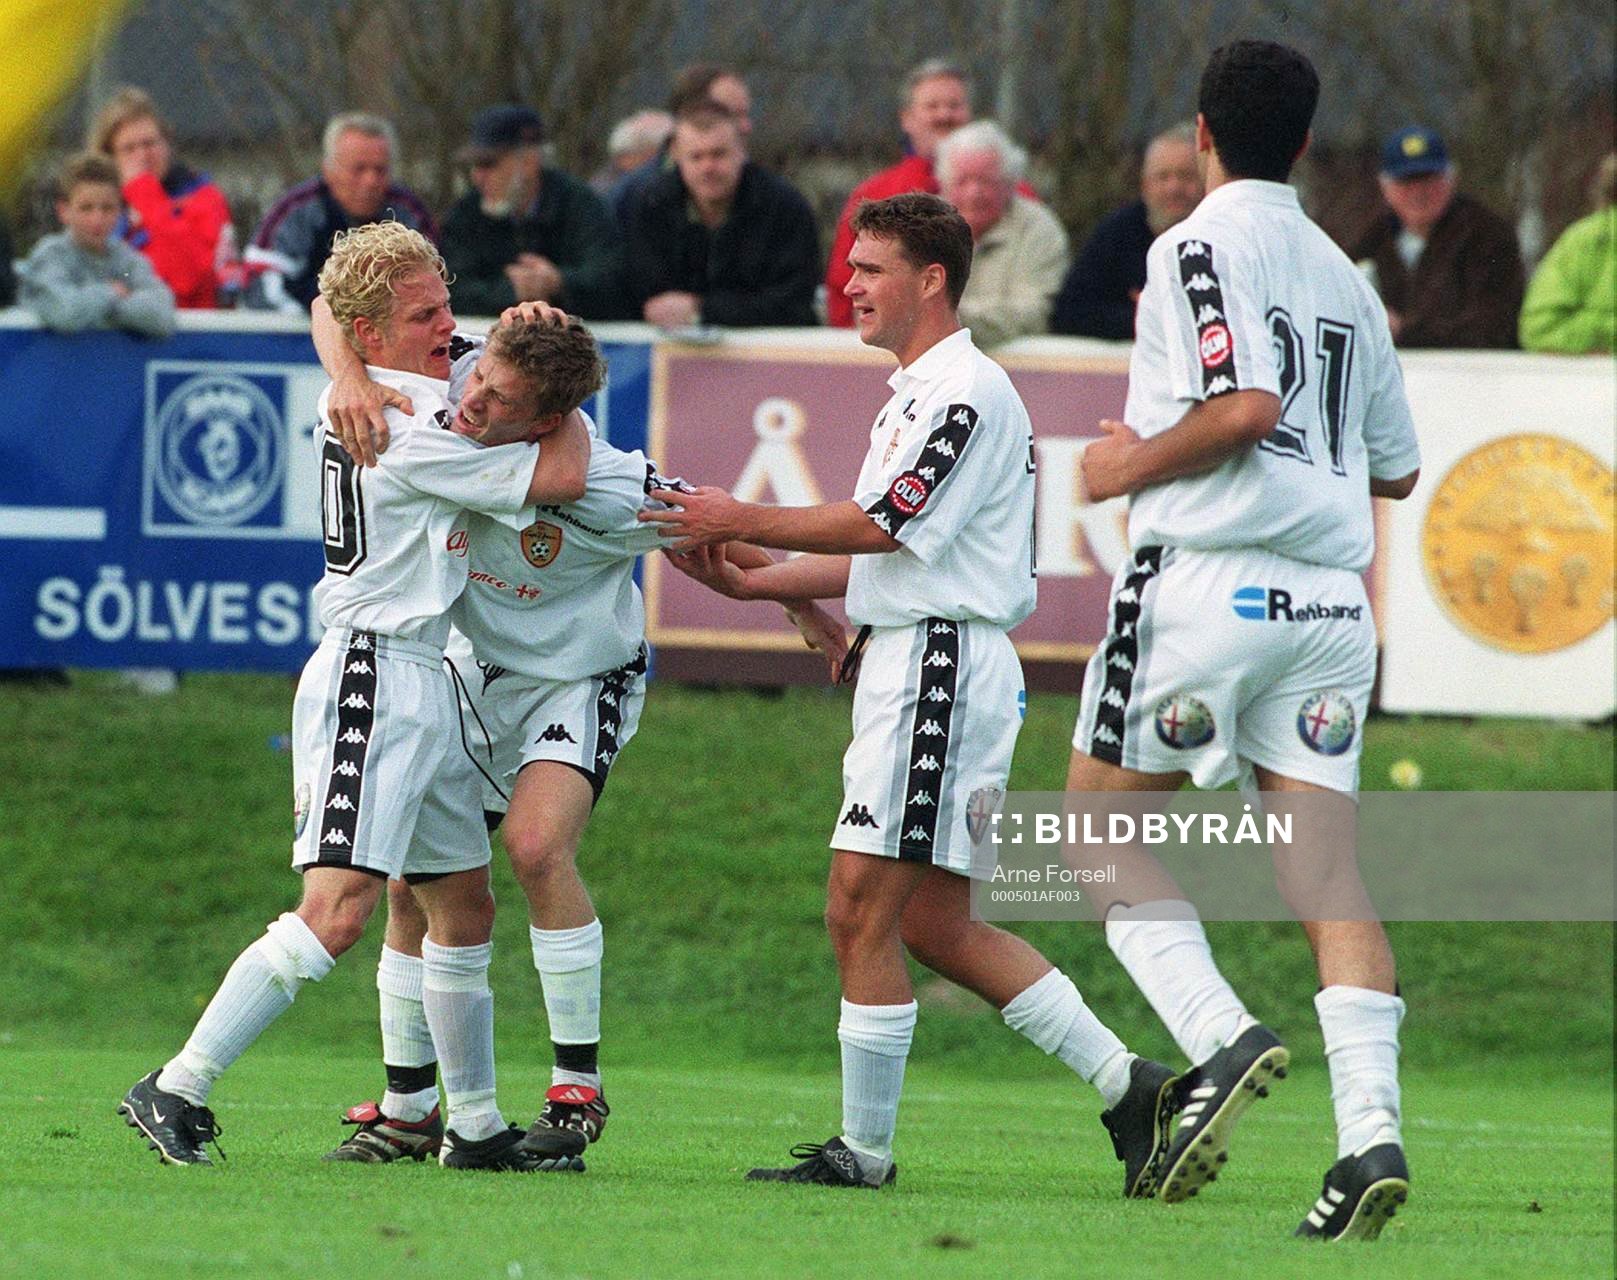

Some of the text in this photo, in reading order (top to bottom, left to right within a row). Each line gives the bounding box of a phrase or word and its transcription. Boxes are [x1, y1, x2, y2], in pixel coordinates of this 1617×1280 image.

[1259, 306, 1355, 476] 21
[894, 479, 926, 506] OLW
[1268, 588, 1362, 622] Rehband
